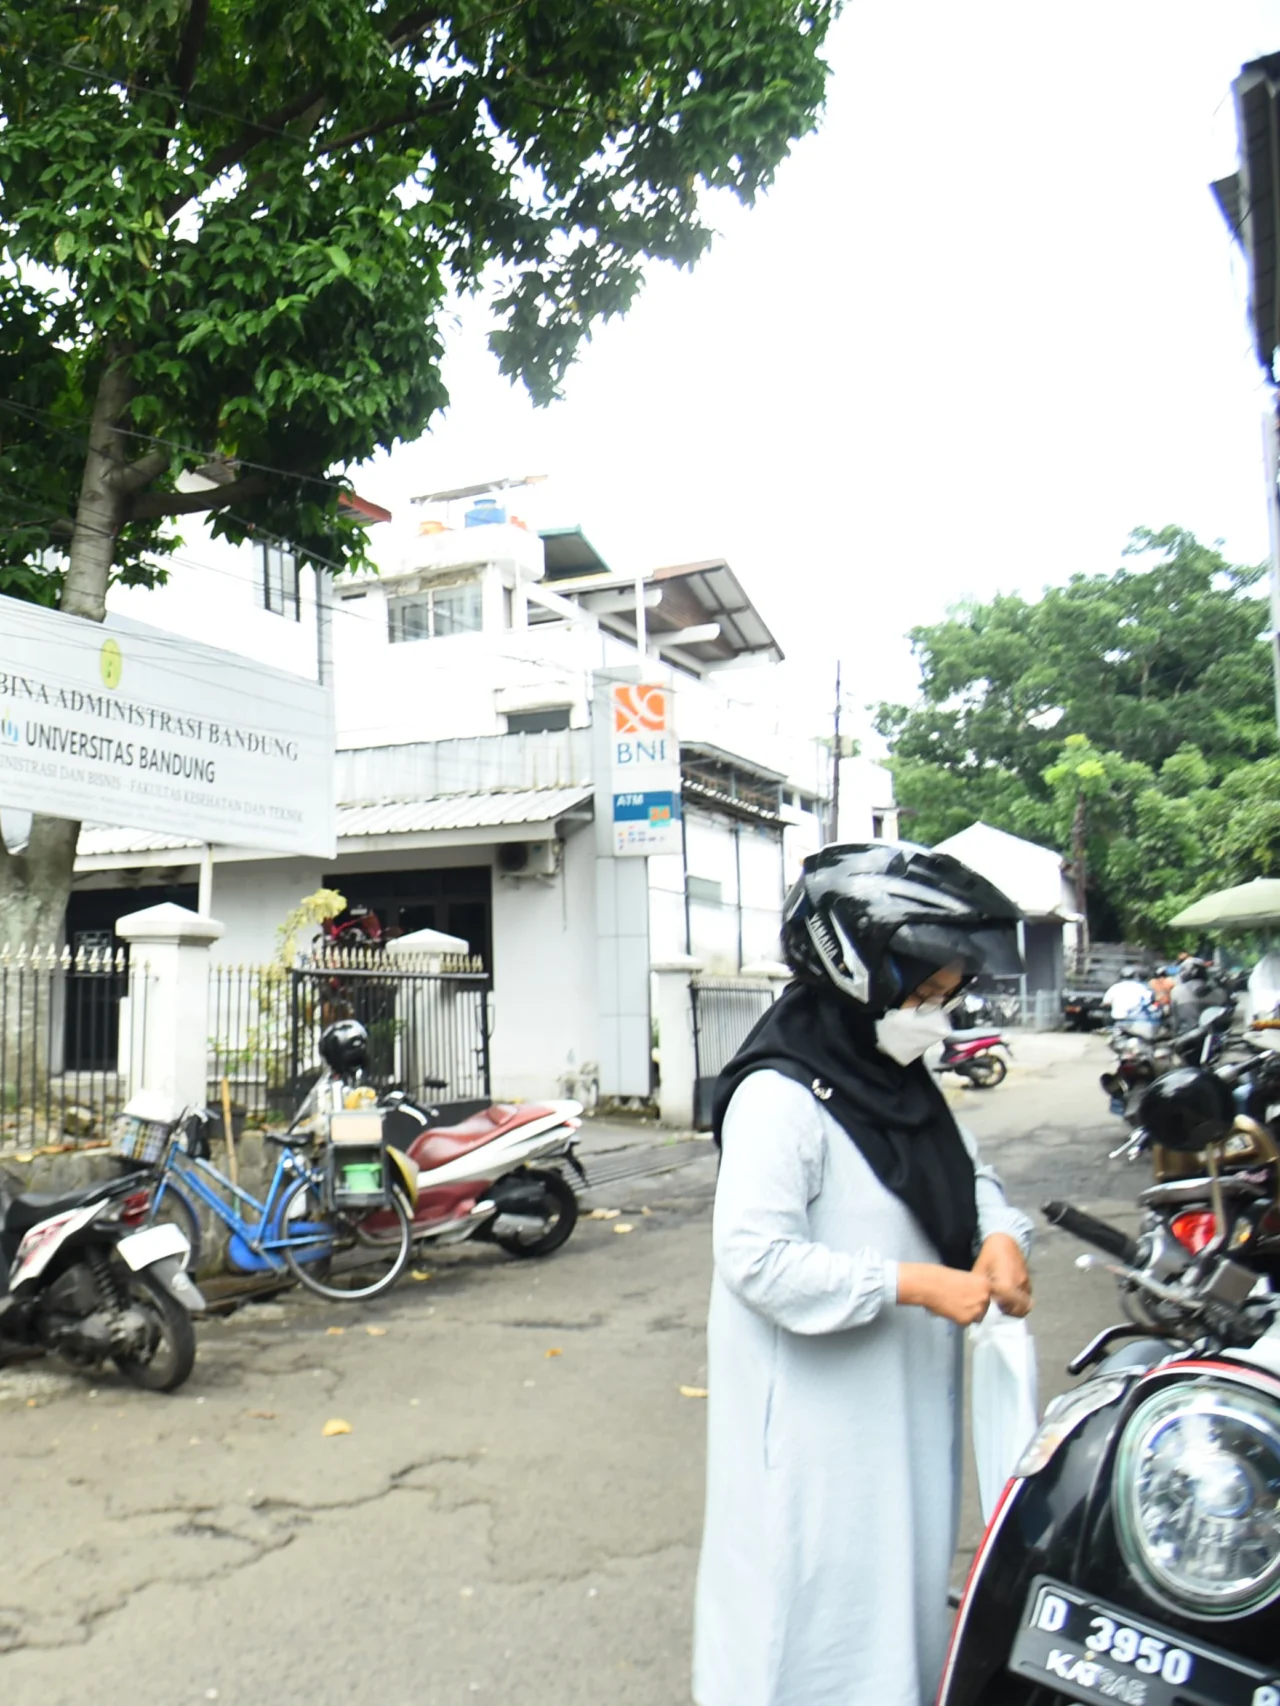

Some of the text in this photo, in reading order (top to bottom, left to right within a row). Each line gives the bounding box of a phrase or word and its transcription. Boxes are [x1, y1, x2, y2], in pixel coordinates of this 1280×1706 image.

[53, 687, 204, 741] ADMINISTRASI
[208, 722, 300, 762] BANDUNG
[25, 720, 216, 783] UNIVERSITAS BANDUNG
[617, 738, 667, 765] BNI
[60, 764, 85, 783] DAN
[130, 779, 182, 802] FAKULTAS
[616, 793, 644, 808] ATM
[808, 911, 840, 961] YAMAHA
[1037, 1595, 1070, 1633] D
[1084, 1616, 1194, 1685] 3950
